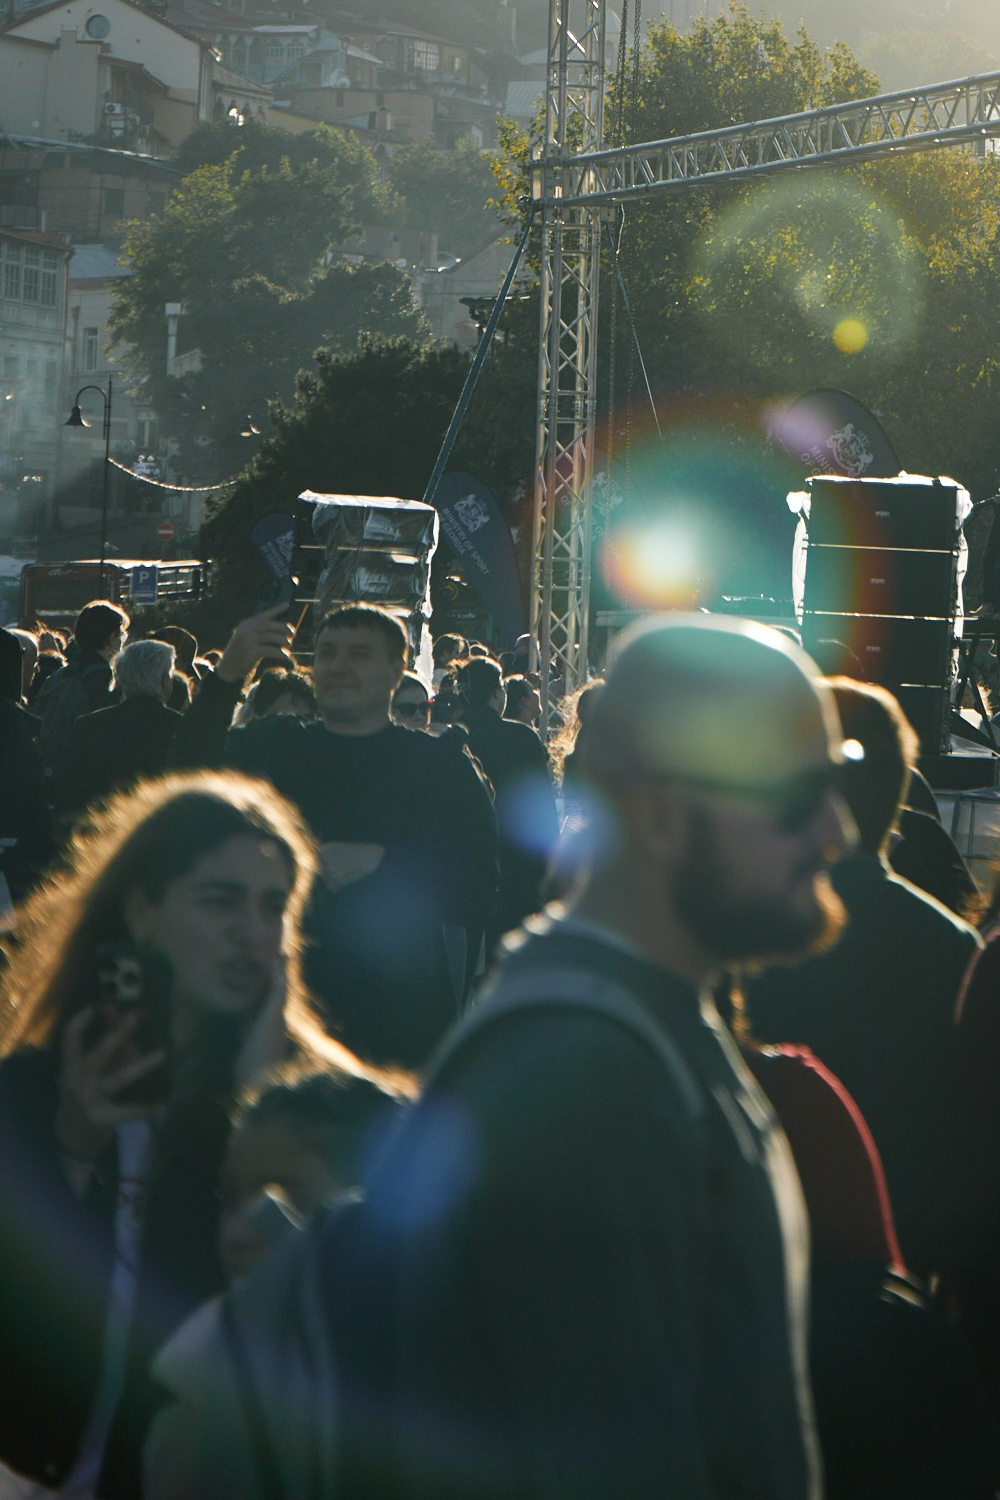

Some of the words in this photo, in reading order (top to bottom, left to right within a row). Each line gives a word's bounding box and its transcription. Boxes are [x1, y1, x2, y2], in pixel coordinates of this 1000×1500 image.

[800, 453, 815, 467] OF
[809, 446, 836, 474] MINIS
[442, 523, 466, 555] GEORGIA
[442, 508, 467, 541] MINISTRY
[464, 540, 475, 551] OF
[470, 551, 490, 575] SPORT
[139, 571, 150, 584] P
